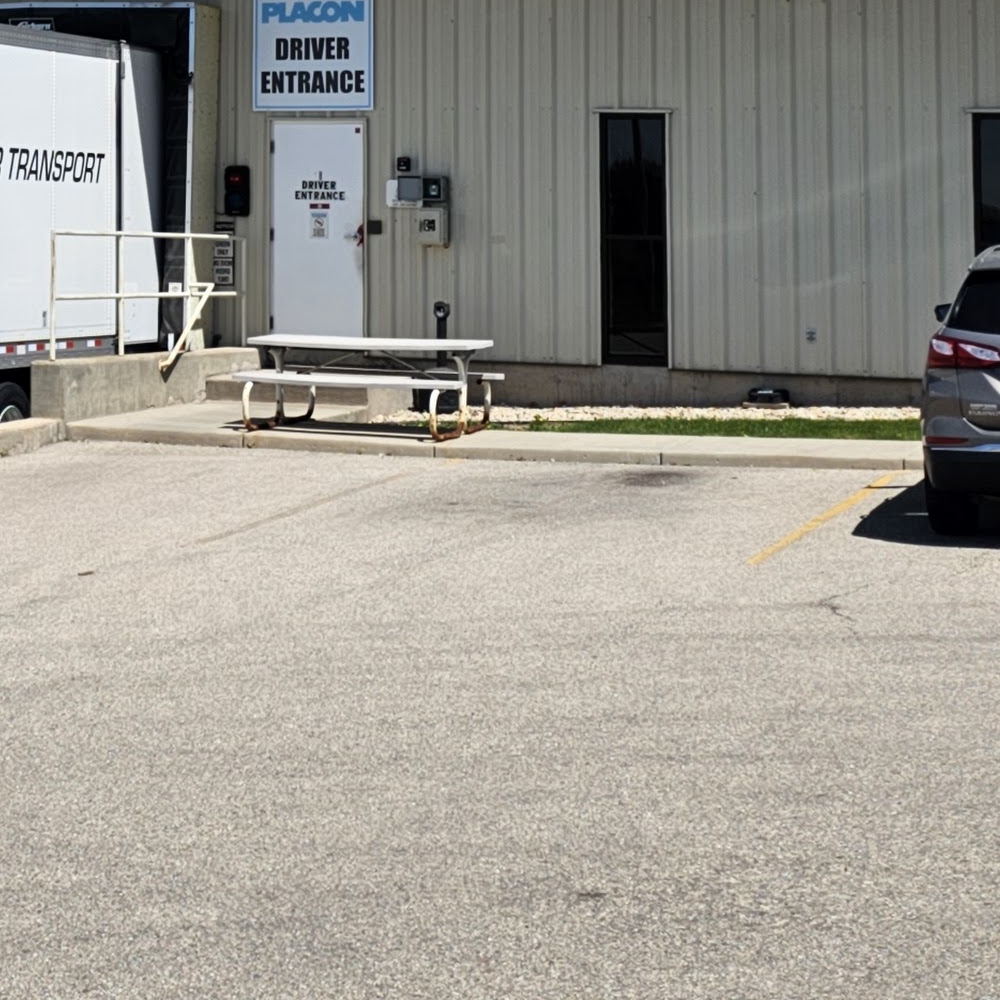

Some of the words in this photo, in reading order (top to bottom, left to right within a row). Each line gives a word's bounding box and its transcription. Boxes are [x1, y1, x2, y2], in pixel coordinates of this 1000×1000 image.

[261, 0, 365, 24] PLACON
[275, 37, 350, 61] DRIVER
[260, 69, 365, 94] ENTRANCE
[8, 147, 106, 184] TRANSPORT
[294, 190, 346, 201] ENTRANCE
[301, 180, 337, 190] DRIVER
